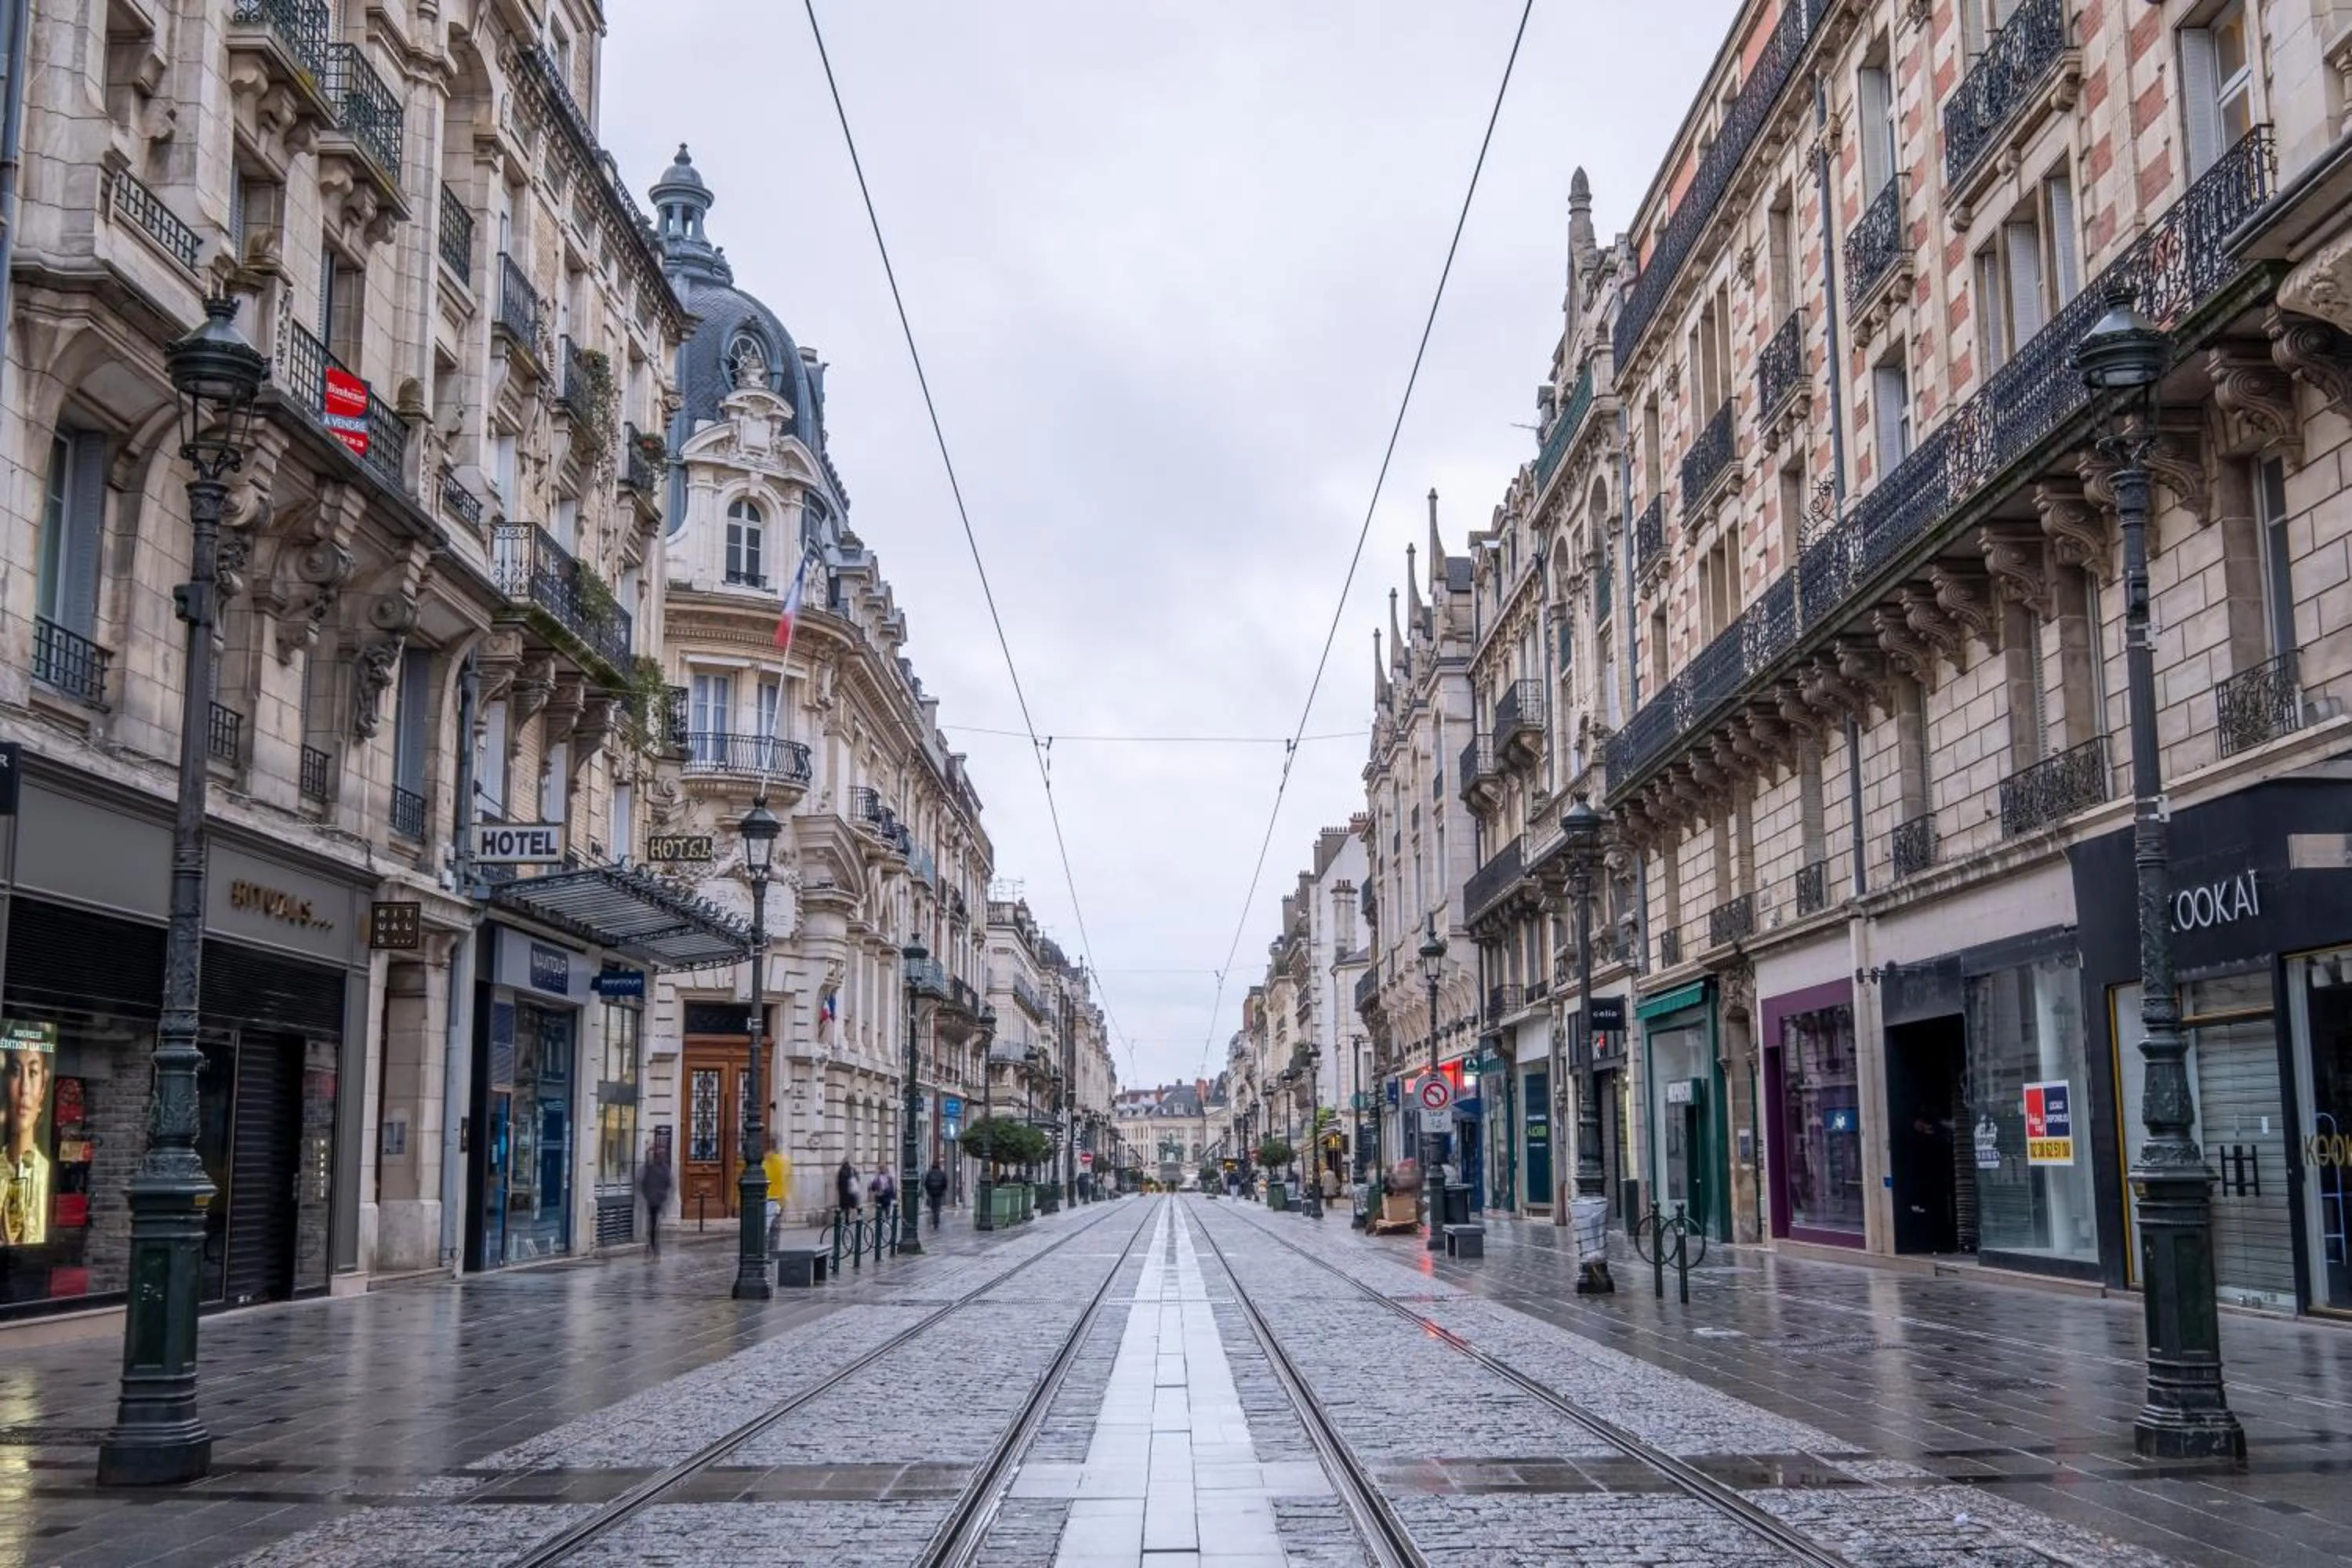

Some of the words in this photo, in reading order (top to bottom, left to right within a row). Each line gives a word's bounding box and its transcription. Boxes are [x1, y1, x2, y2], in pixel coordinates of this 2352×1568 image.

[481, 831, 557, 855] HOTEL
[650, 837, 712, 859] HOTEL
[2168, 869, 2259, 932] OOKAÏ
